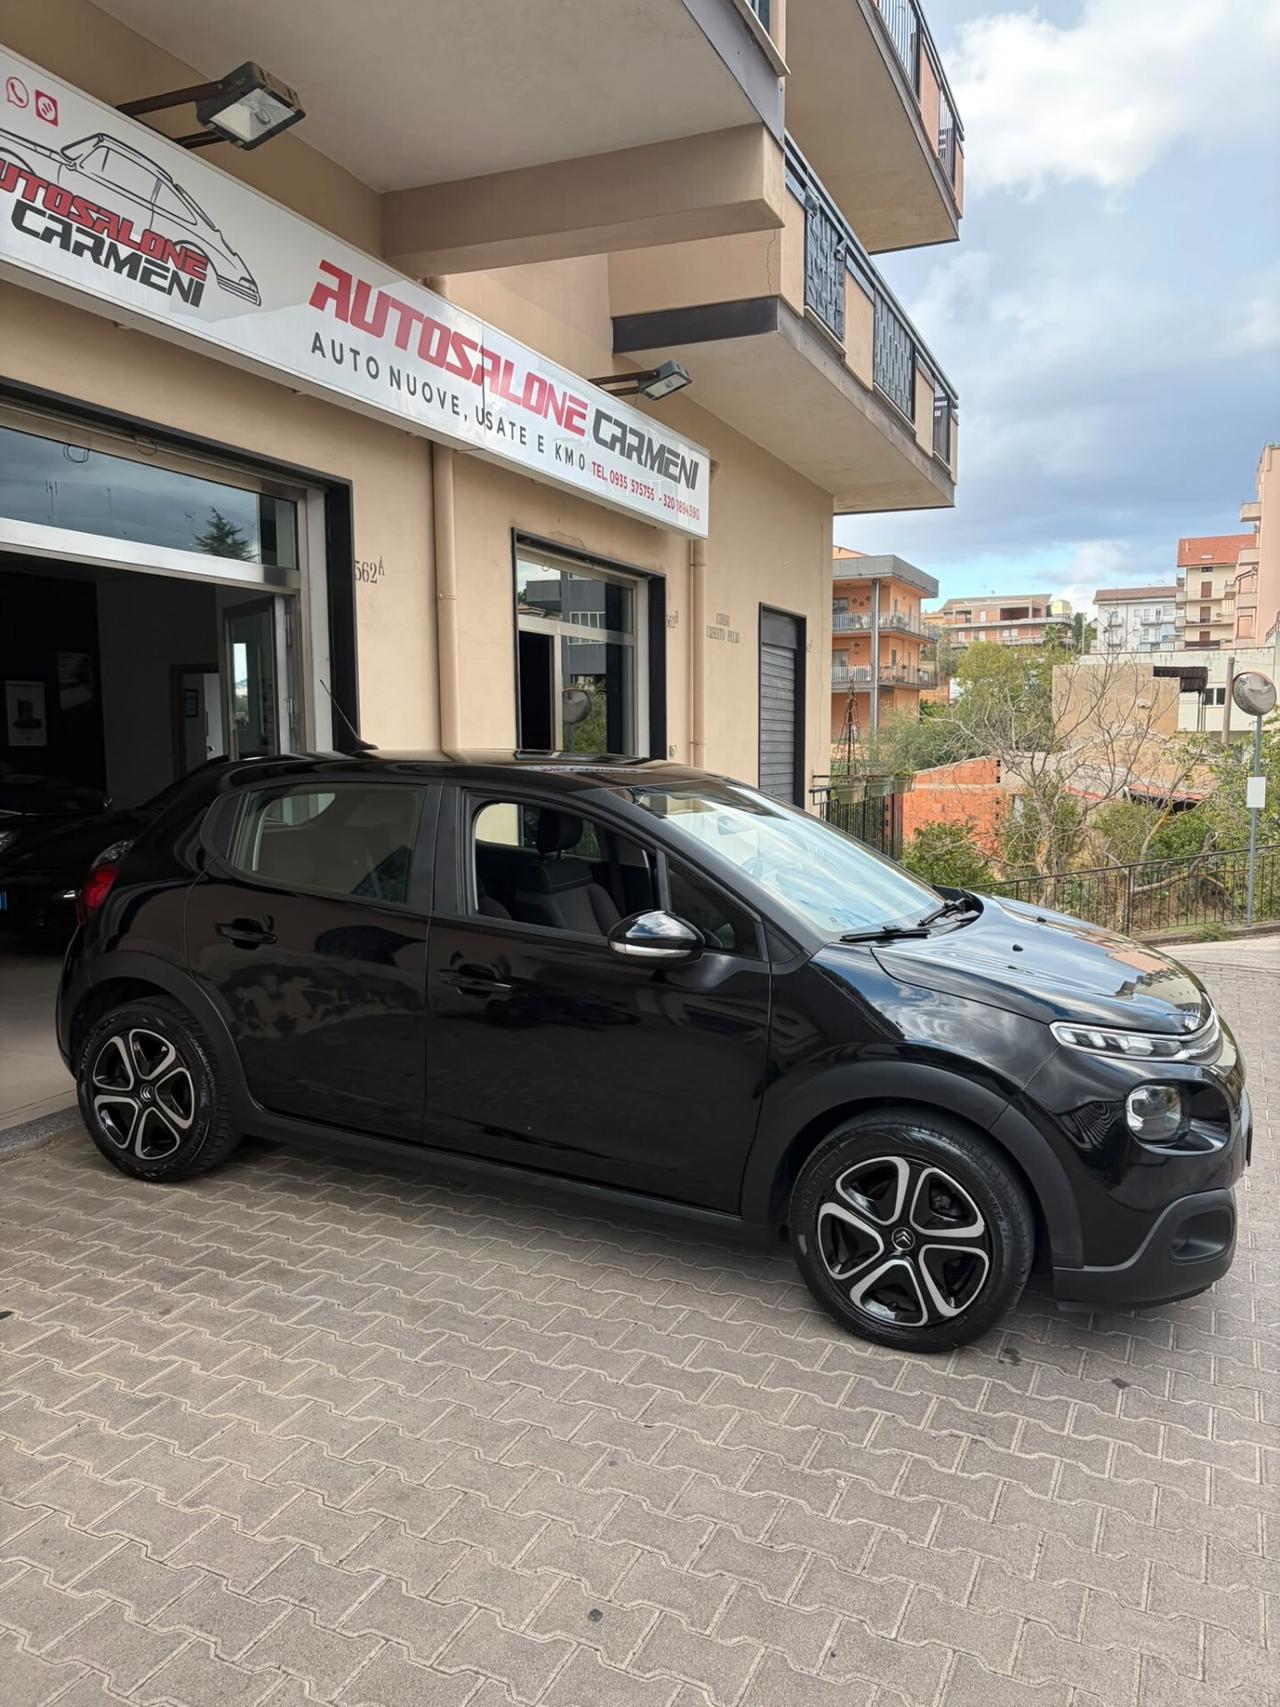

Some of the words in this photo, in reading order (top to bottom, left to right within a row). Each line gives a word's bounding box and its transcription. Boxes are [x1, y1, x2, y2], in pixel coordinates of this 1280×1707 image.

[0, 159, 209, 281] UTOSALONE
[11, 198, 205, 307] CARMENI
[309, 259, 588, 437] AUTOSALONE
[592, 408, 699, 491] CARMENI
[311, 332, 380, 380] AUTO
[389, 365, 468, 421] NUOVE,
[475, 405, 527, 446] USATE
[537, 434, 545, 454] E
[610, 470, 628, 490] 0935
[631, 479, 655, 501] 575755
